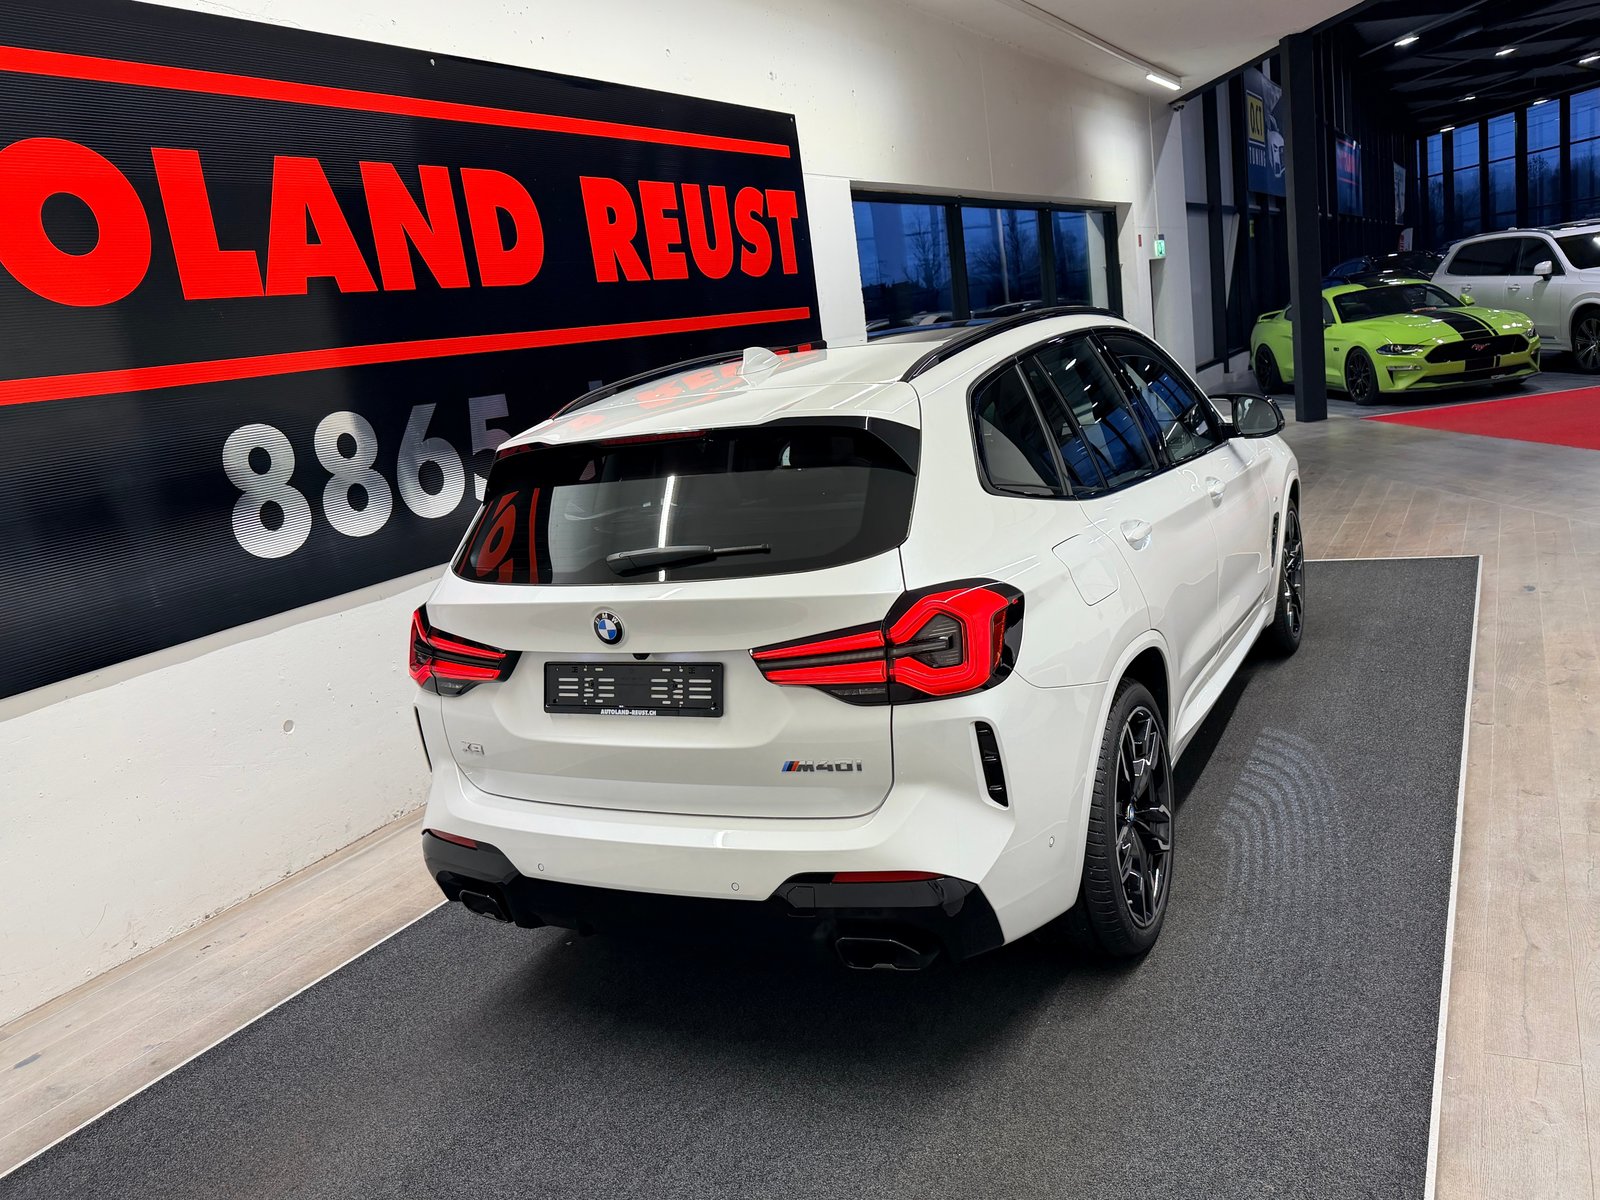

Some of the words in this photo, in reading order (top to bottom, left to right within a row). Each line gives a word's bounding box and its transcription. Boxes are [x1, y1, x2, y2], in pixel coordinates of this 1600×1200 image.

[0, 137, 545, 307] OLAND
[579, 175, 799, 283] REUST
[222, 394, 512, 558] 8865
